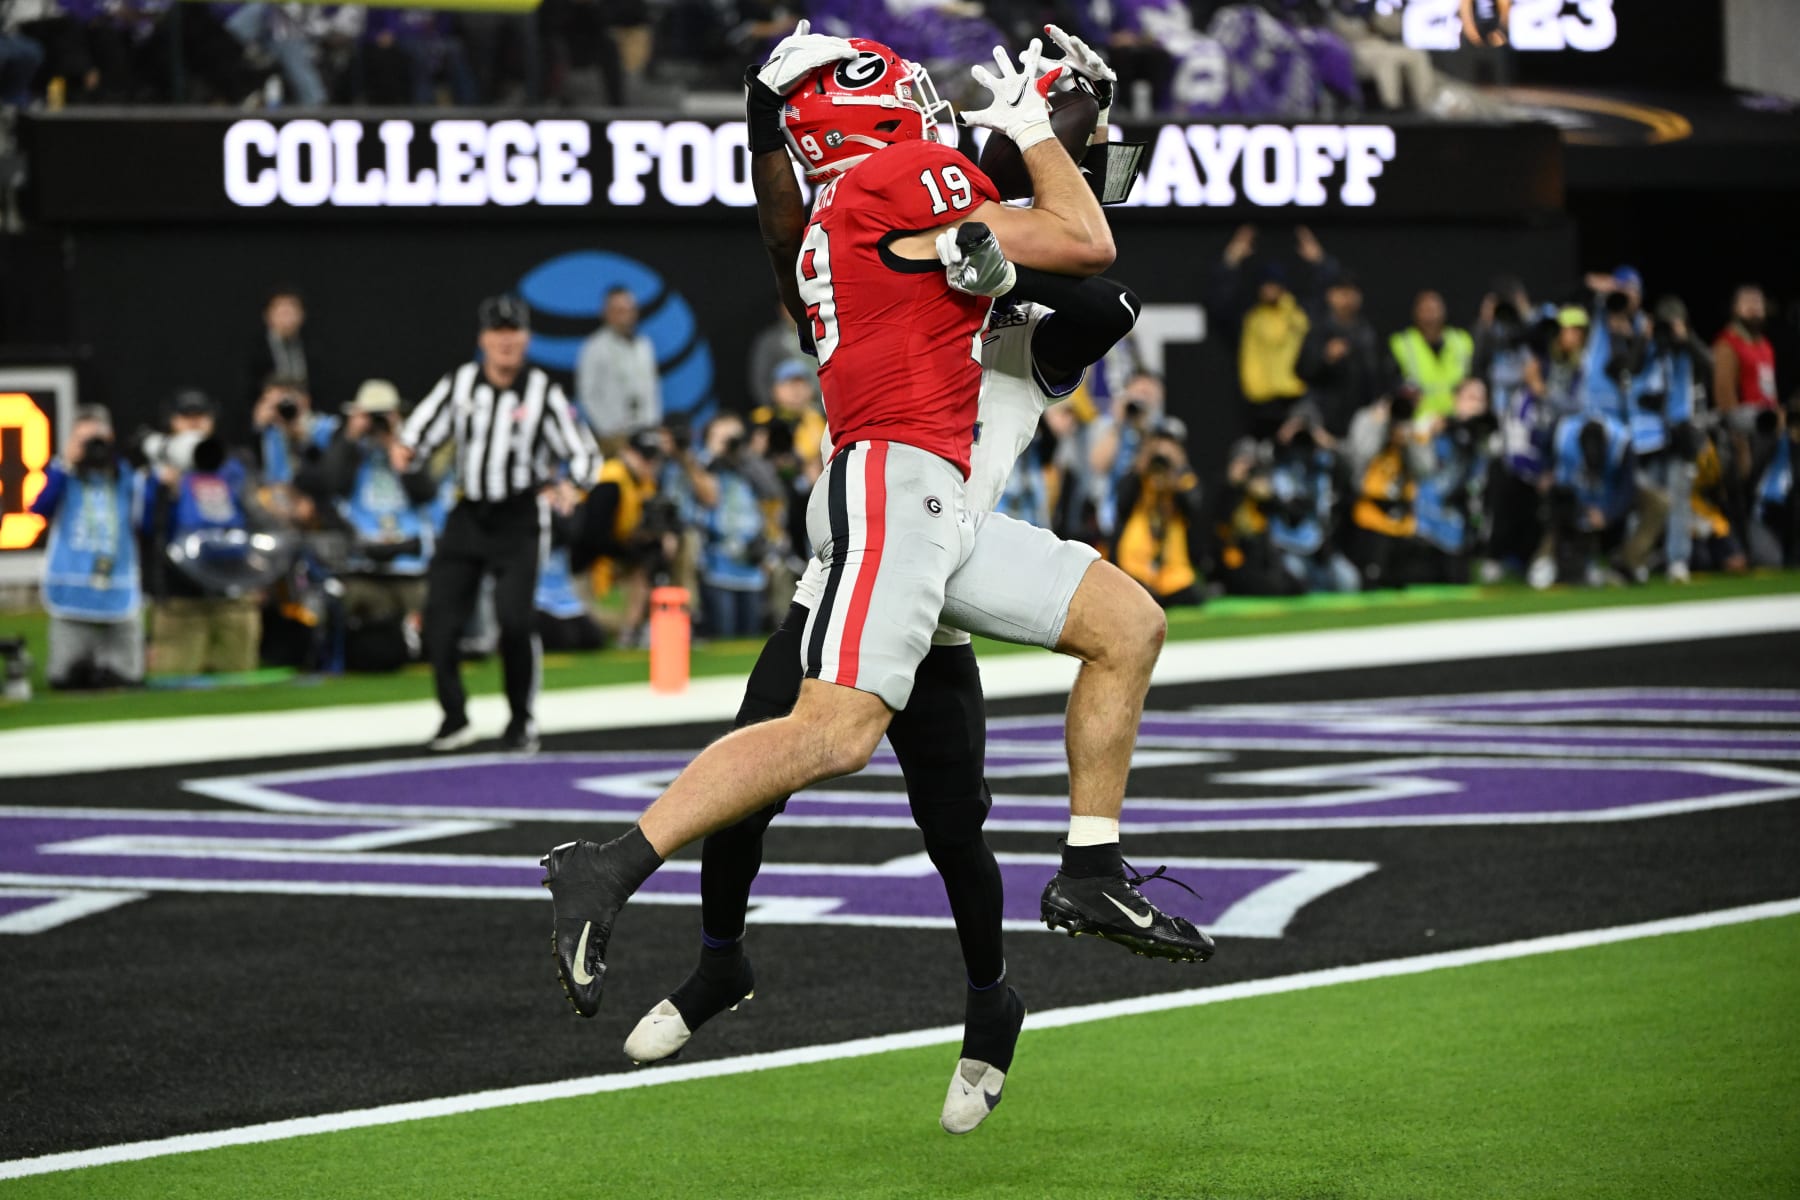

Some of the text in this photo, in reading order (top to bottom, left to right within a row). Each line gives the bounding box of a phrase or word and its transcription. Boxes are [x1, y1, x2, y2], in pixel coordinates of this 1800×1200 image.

[223, 120, 592, 207] COLLEGE
[1106, 123, 1396, 208] AYOFF
[919, 164, 972, 215] 19
